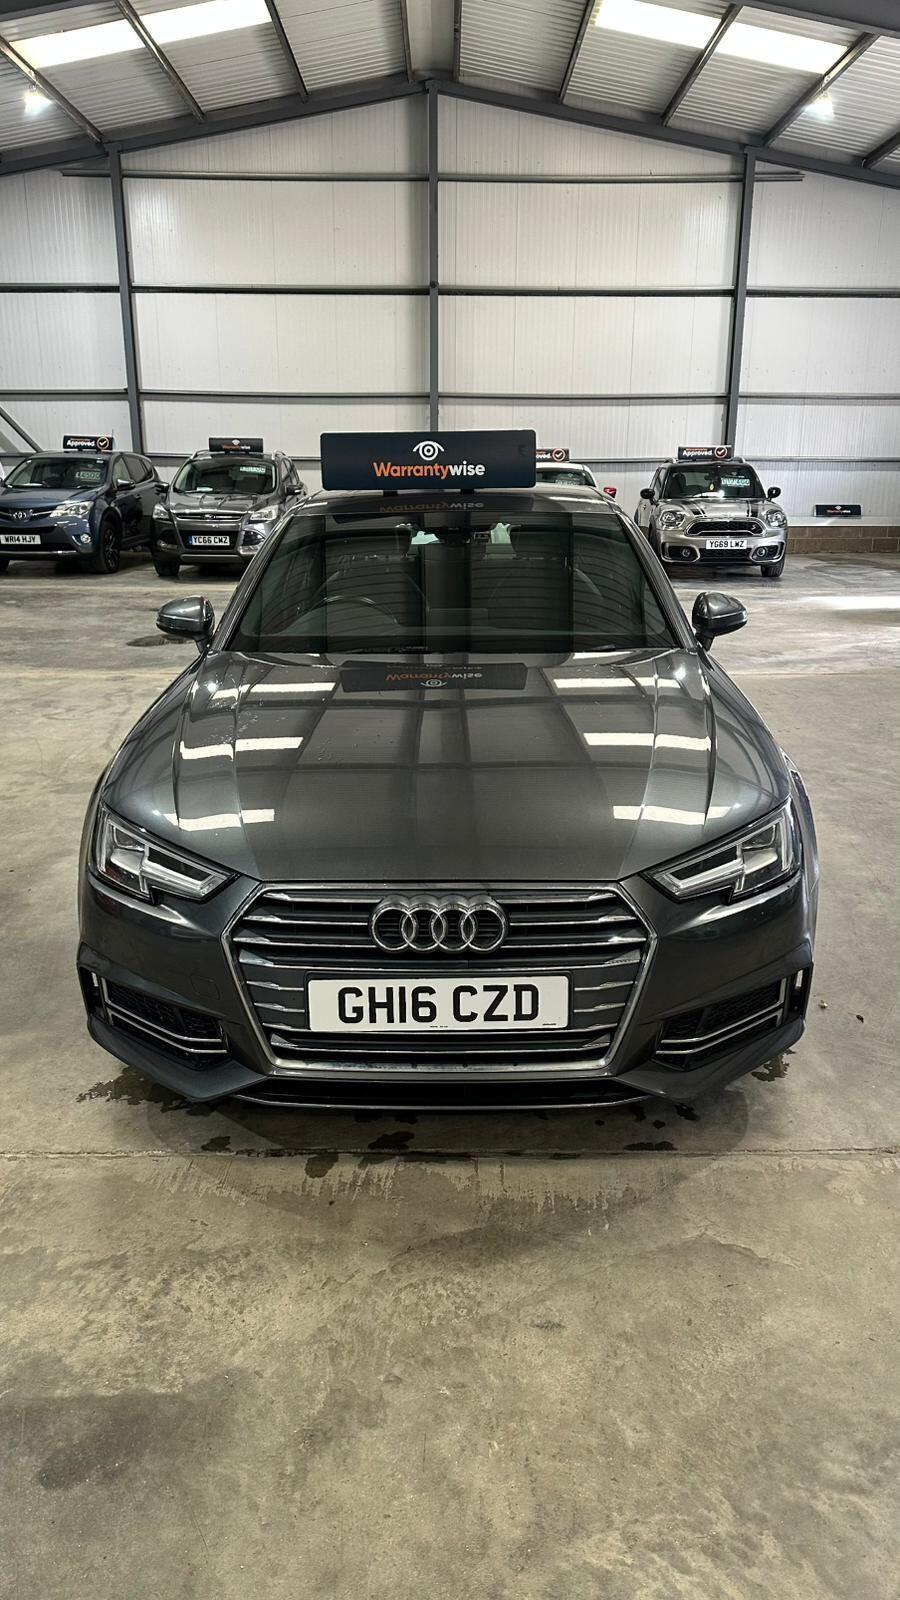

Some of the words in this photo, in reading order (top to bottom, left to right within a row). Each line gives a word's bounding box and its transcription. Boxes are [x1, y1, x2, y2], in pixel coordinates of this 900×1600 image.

[373, 460, 486, 480] Warrantywise
[4, 535, 21, 543] WR14
[21, 535, 36, 543] HJY
[193, 536, 212, 544] YC66
[709, 540, 729, 548] YG69
[337, 985, 437, 1024] GH16
[452, 983, 540, 1022] CZD
